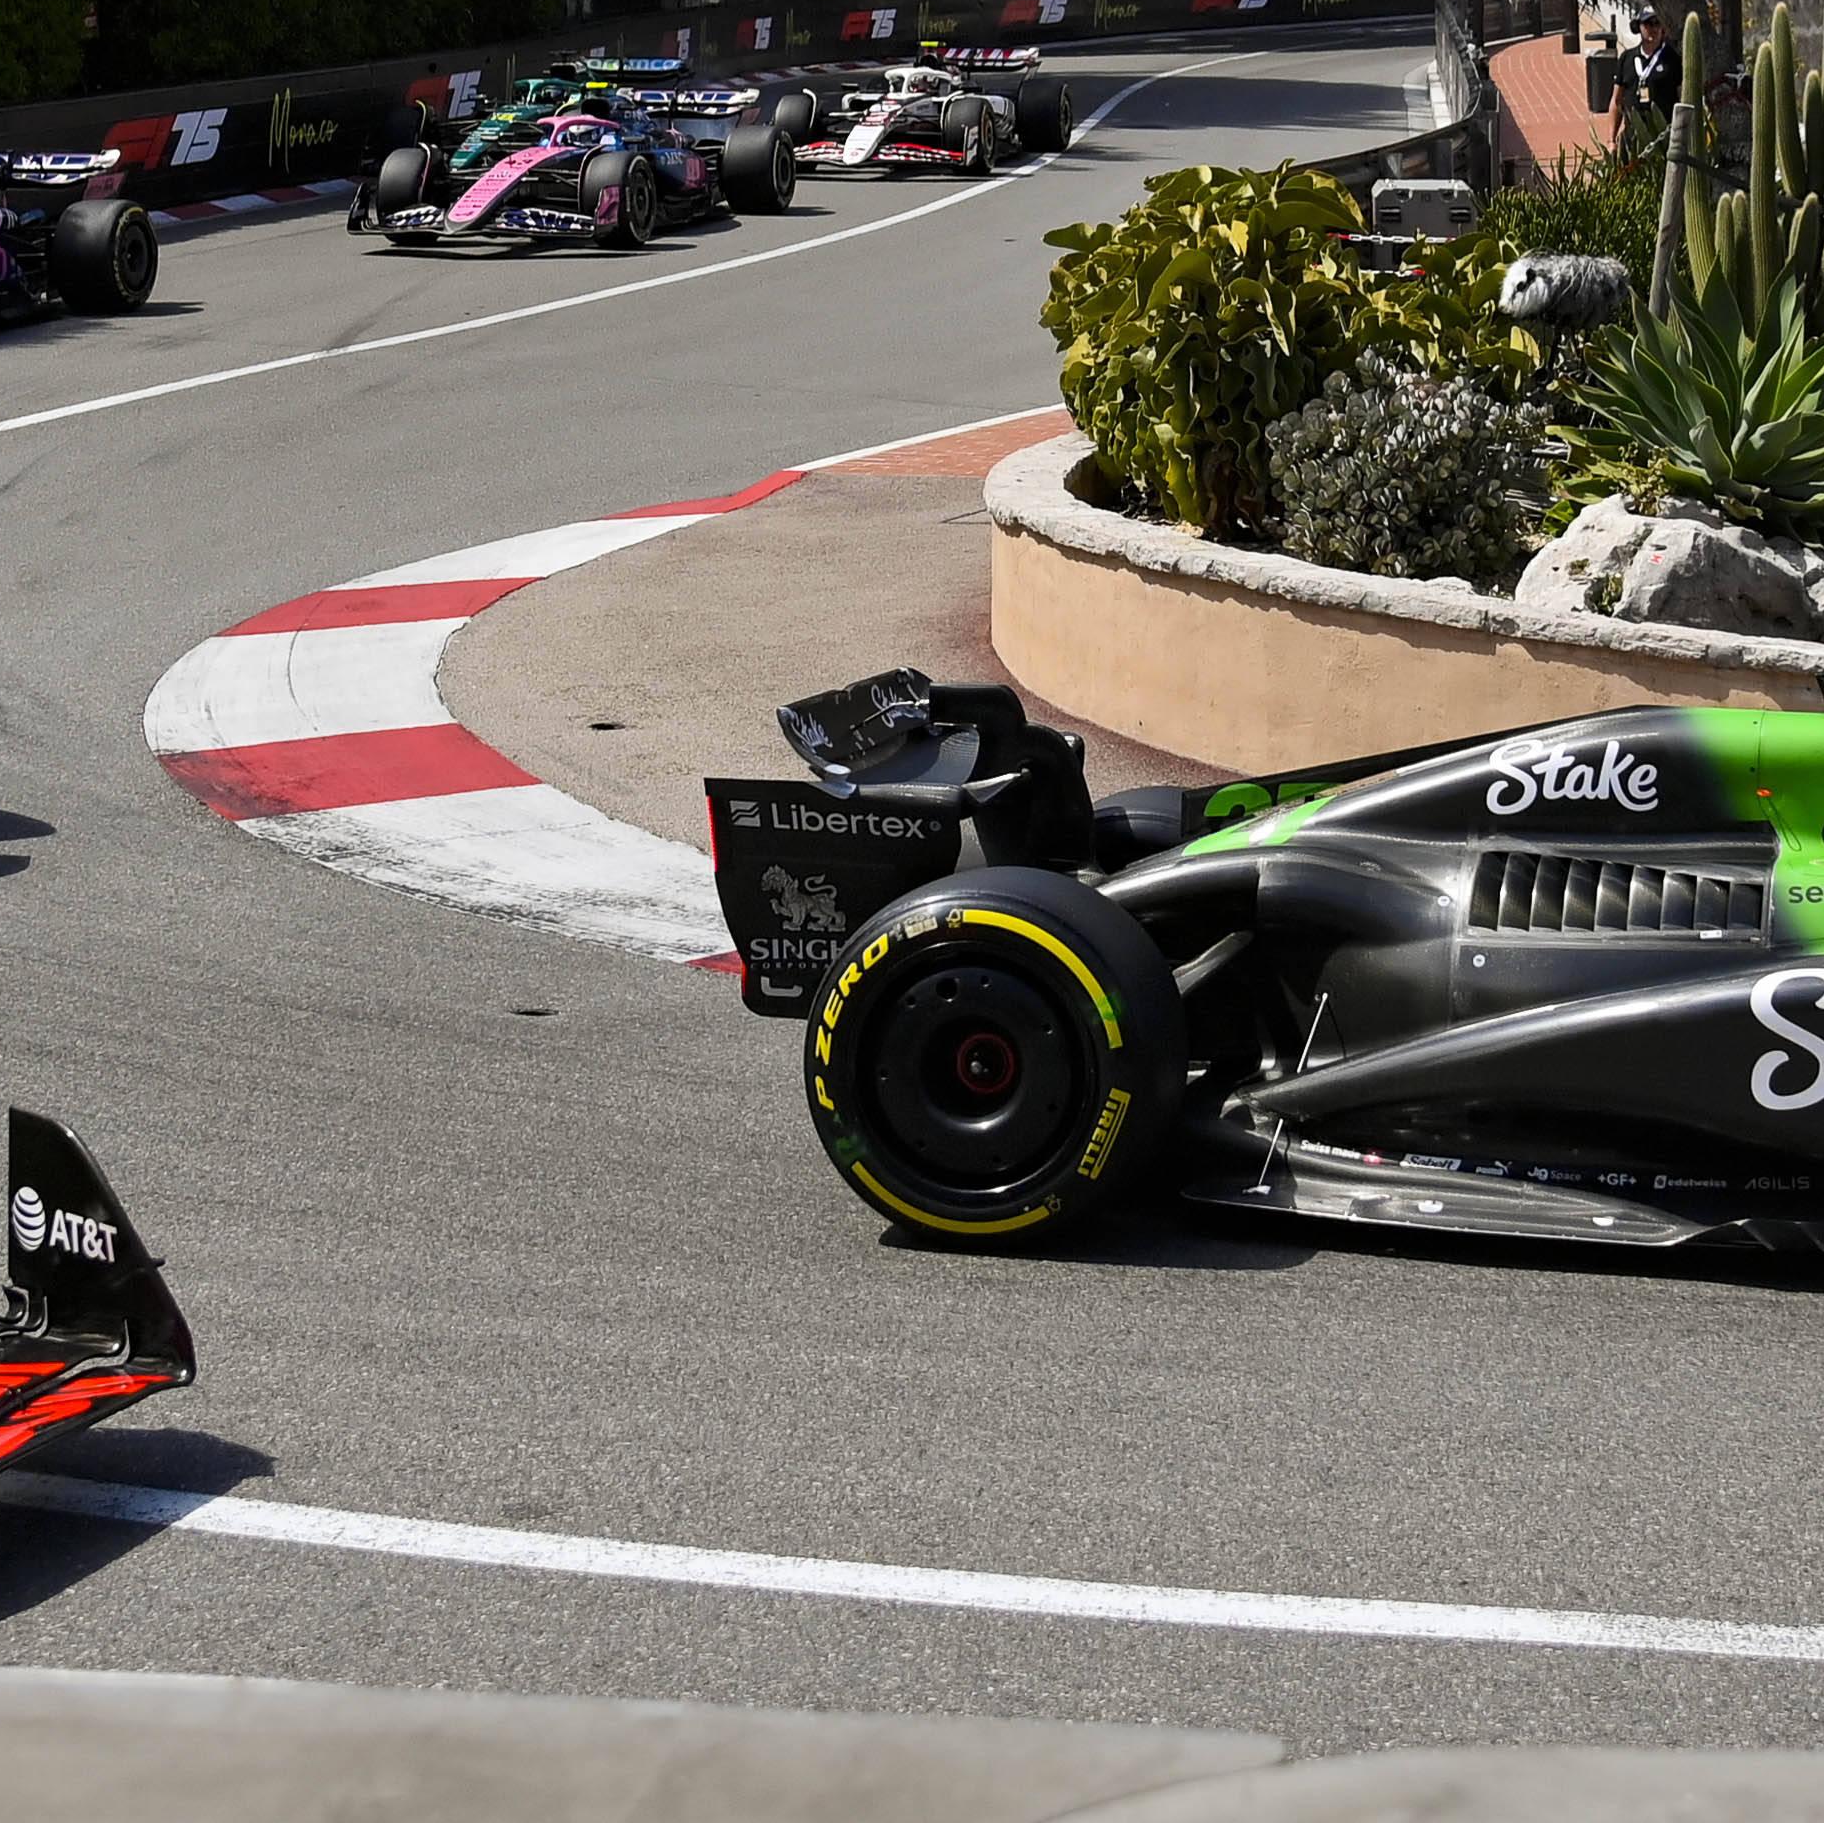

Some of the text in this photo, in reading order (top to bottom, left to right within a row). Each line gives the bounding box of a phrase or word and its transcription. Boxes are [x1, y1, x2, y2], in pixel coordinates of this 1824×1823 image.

[871, 9, 897, 39] 75
[586, 58, 681, 71] armco
[170, 108, 227, 166] 75
[268, 87, 338, 175] Monaco
[1486, 739, 1659, 815] Stake
[771, 802, 926, 840] Libertex
[750, 938, 848, 963] SINGH
[750, 961, 833, 970] CORPORA
[814, 932, 891, 1112] P ZERO
[1077, 1087, 1132, 1180] PIRELLI
[1300, 1139, 1361, 1160] Swiss made
[1745, 1176, 1811, 1190] AGILIS
[49, 1209, 119, 1264] AT&T
